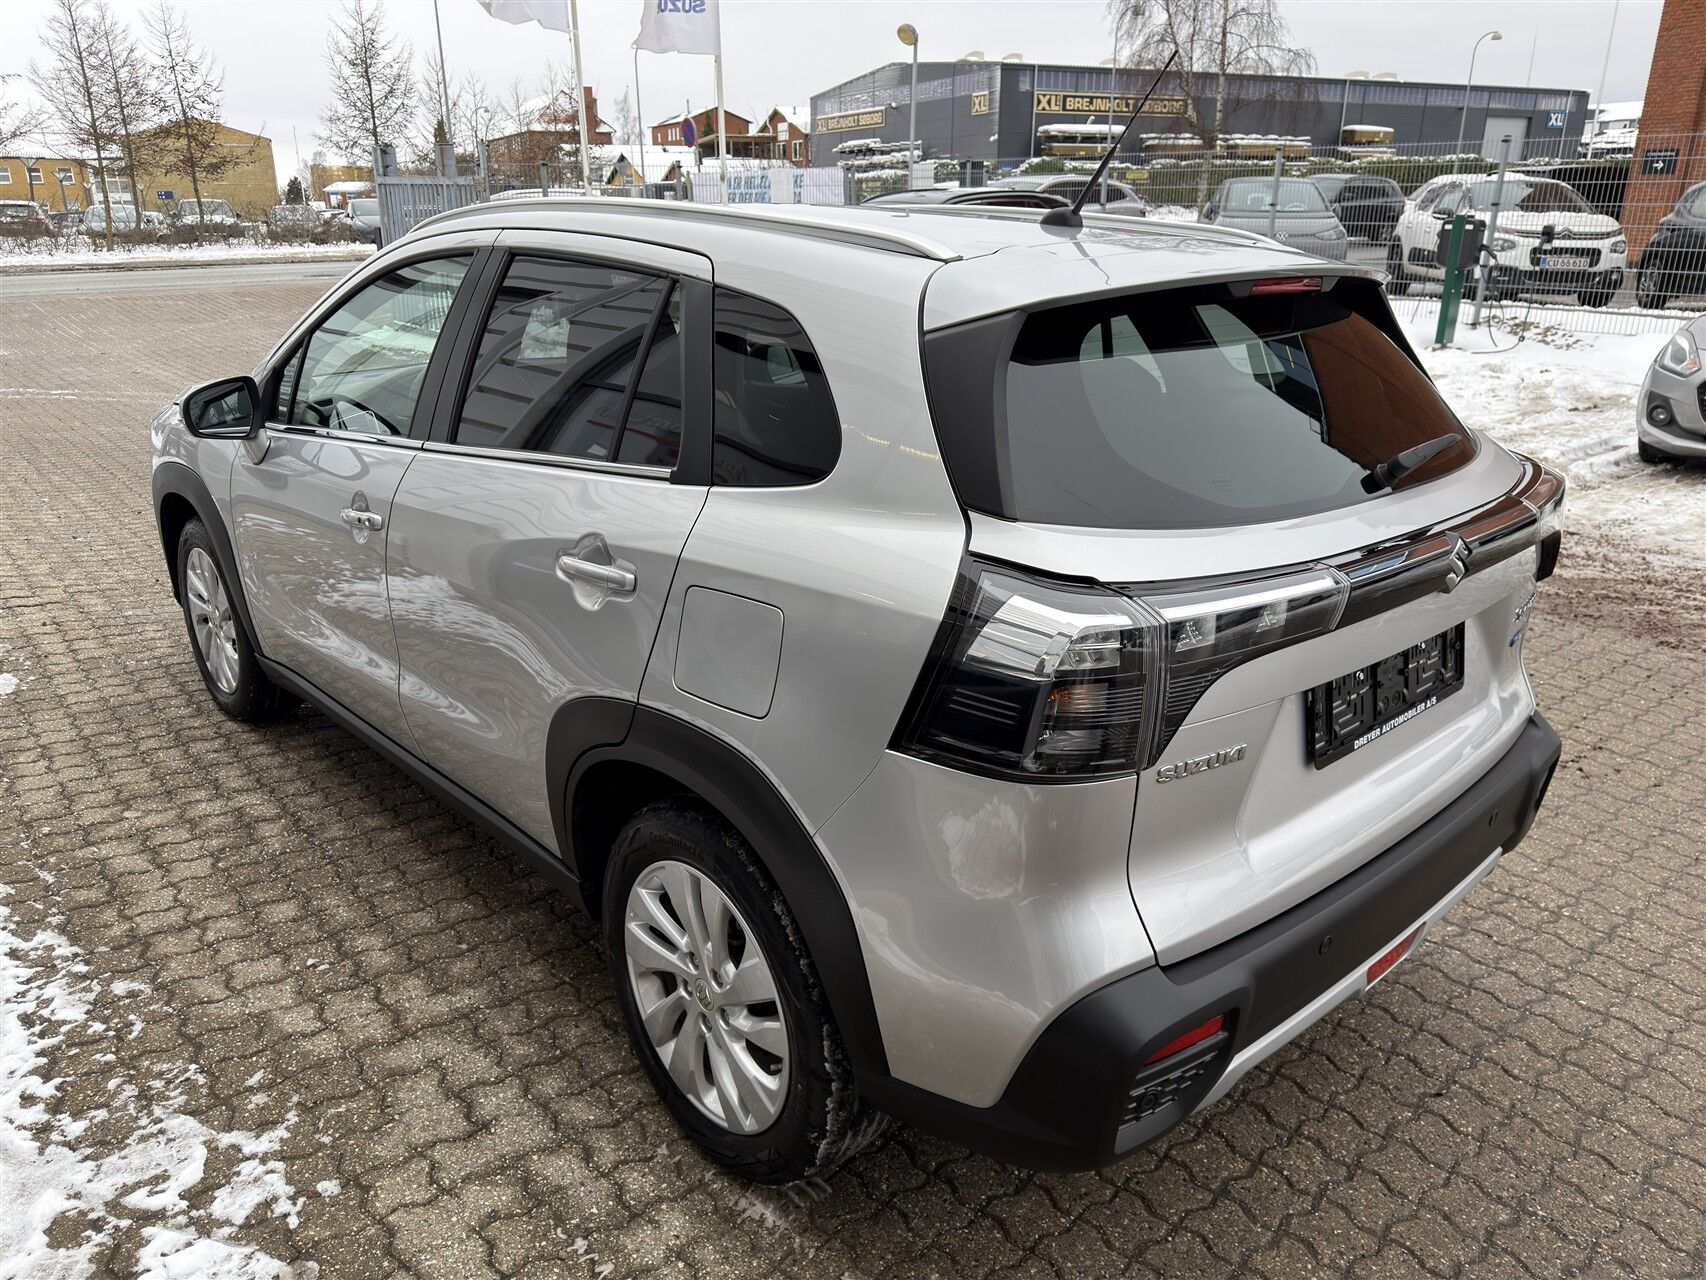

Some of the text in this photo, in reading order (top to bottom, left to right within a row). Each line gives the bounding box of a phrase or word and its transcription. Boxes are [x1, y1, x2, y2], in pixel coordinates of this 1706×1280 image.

[1065, 97, 1135, 112] BREJNHOLT
[1354, 696, 1436, 749] DREYER AUTOMOBILER A/S
[1156, 743, 1247, 784] SUZUKI
